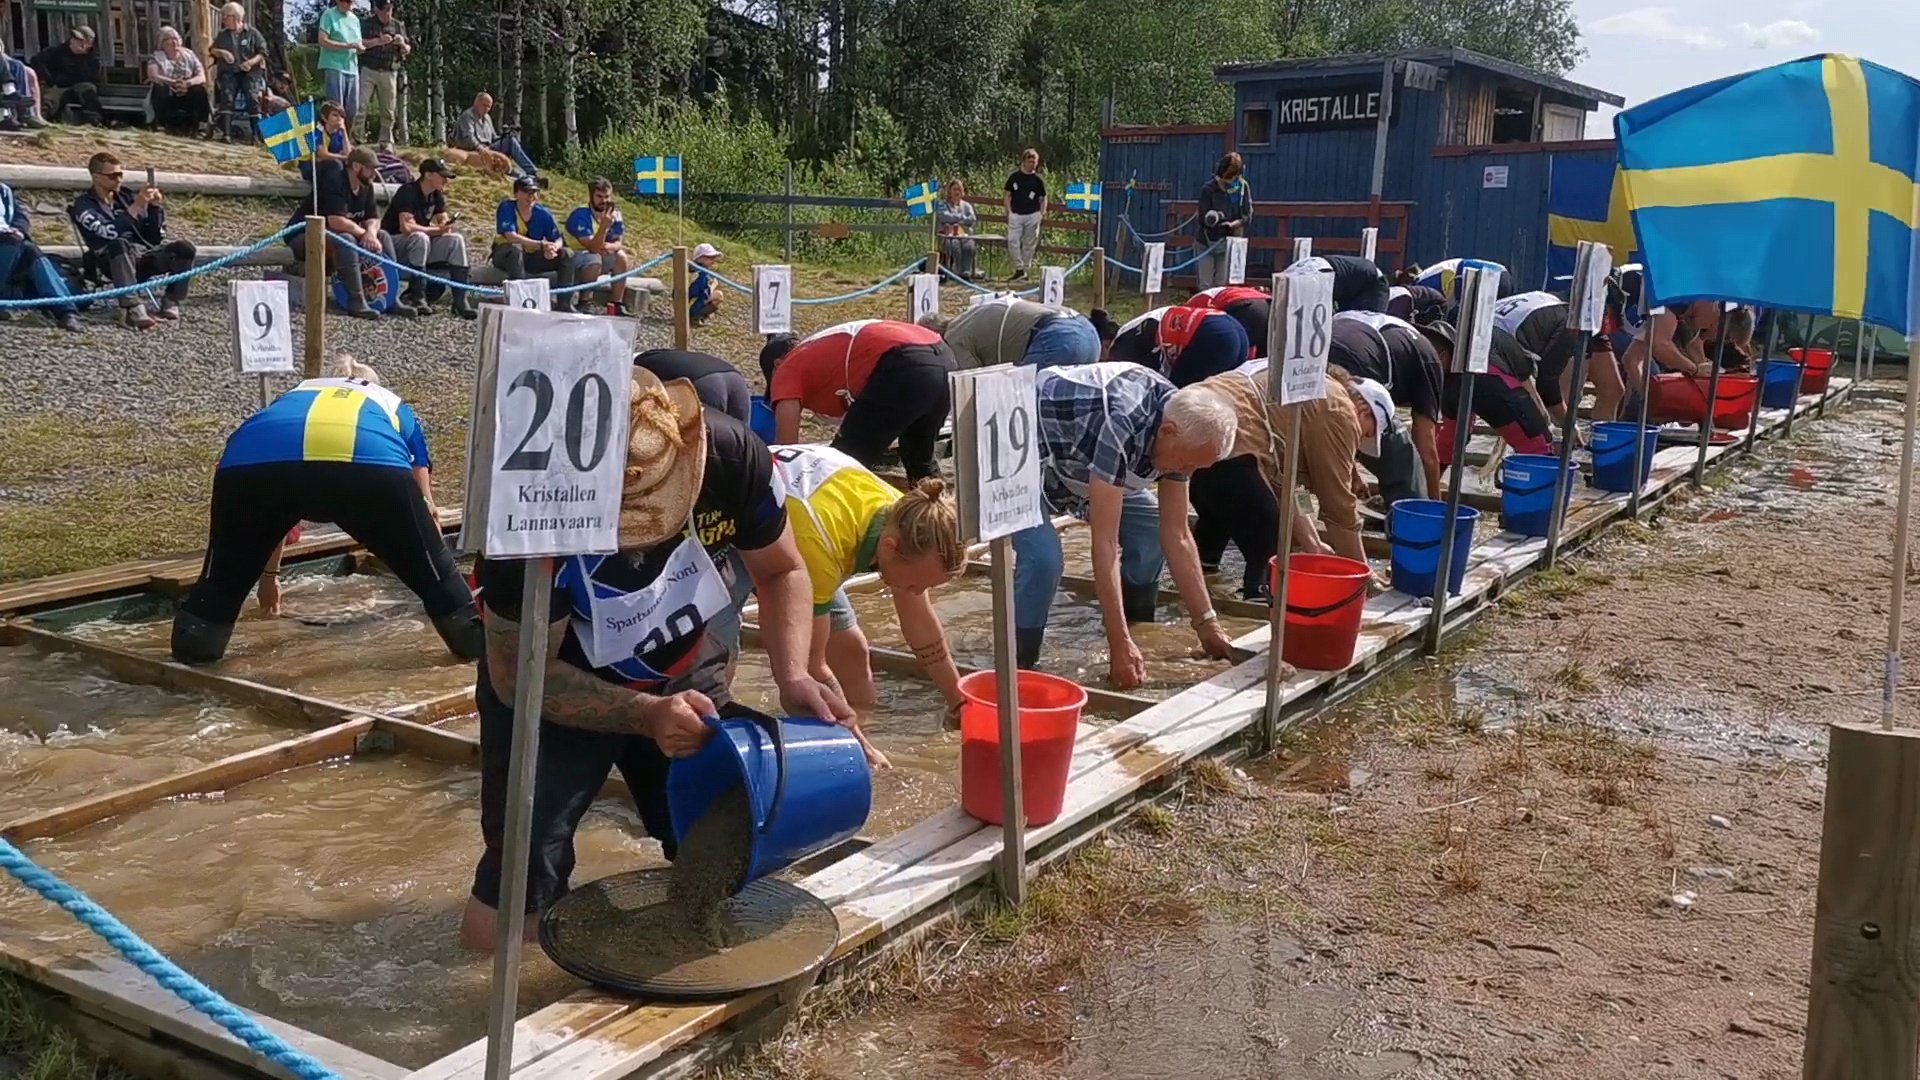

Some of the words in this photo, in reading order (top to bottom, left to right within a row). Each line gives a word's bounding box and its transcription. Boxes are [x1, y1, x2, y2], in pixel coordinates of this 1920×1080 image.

[1280, 93, 1380, 123] KRISTALLE
[768, 281, 780, 310] 7
[921, 288, 931, 314] 6
[1049, 280, 1058, 304] 5
[252, 302, 273, 341] 9
[1289, 303, 1326, 360] 18
[501, 368, 613, 473] 20
[984, 406, 1030, 483] 19
[518, 484, 597, 504] Kristallen
[506, 514, 602, 534] Lannavaara
